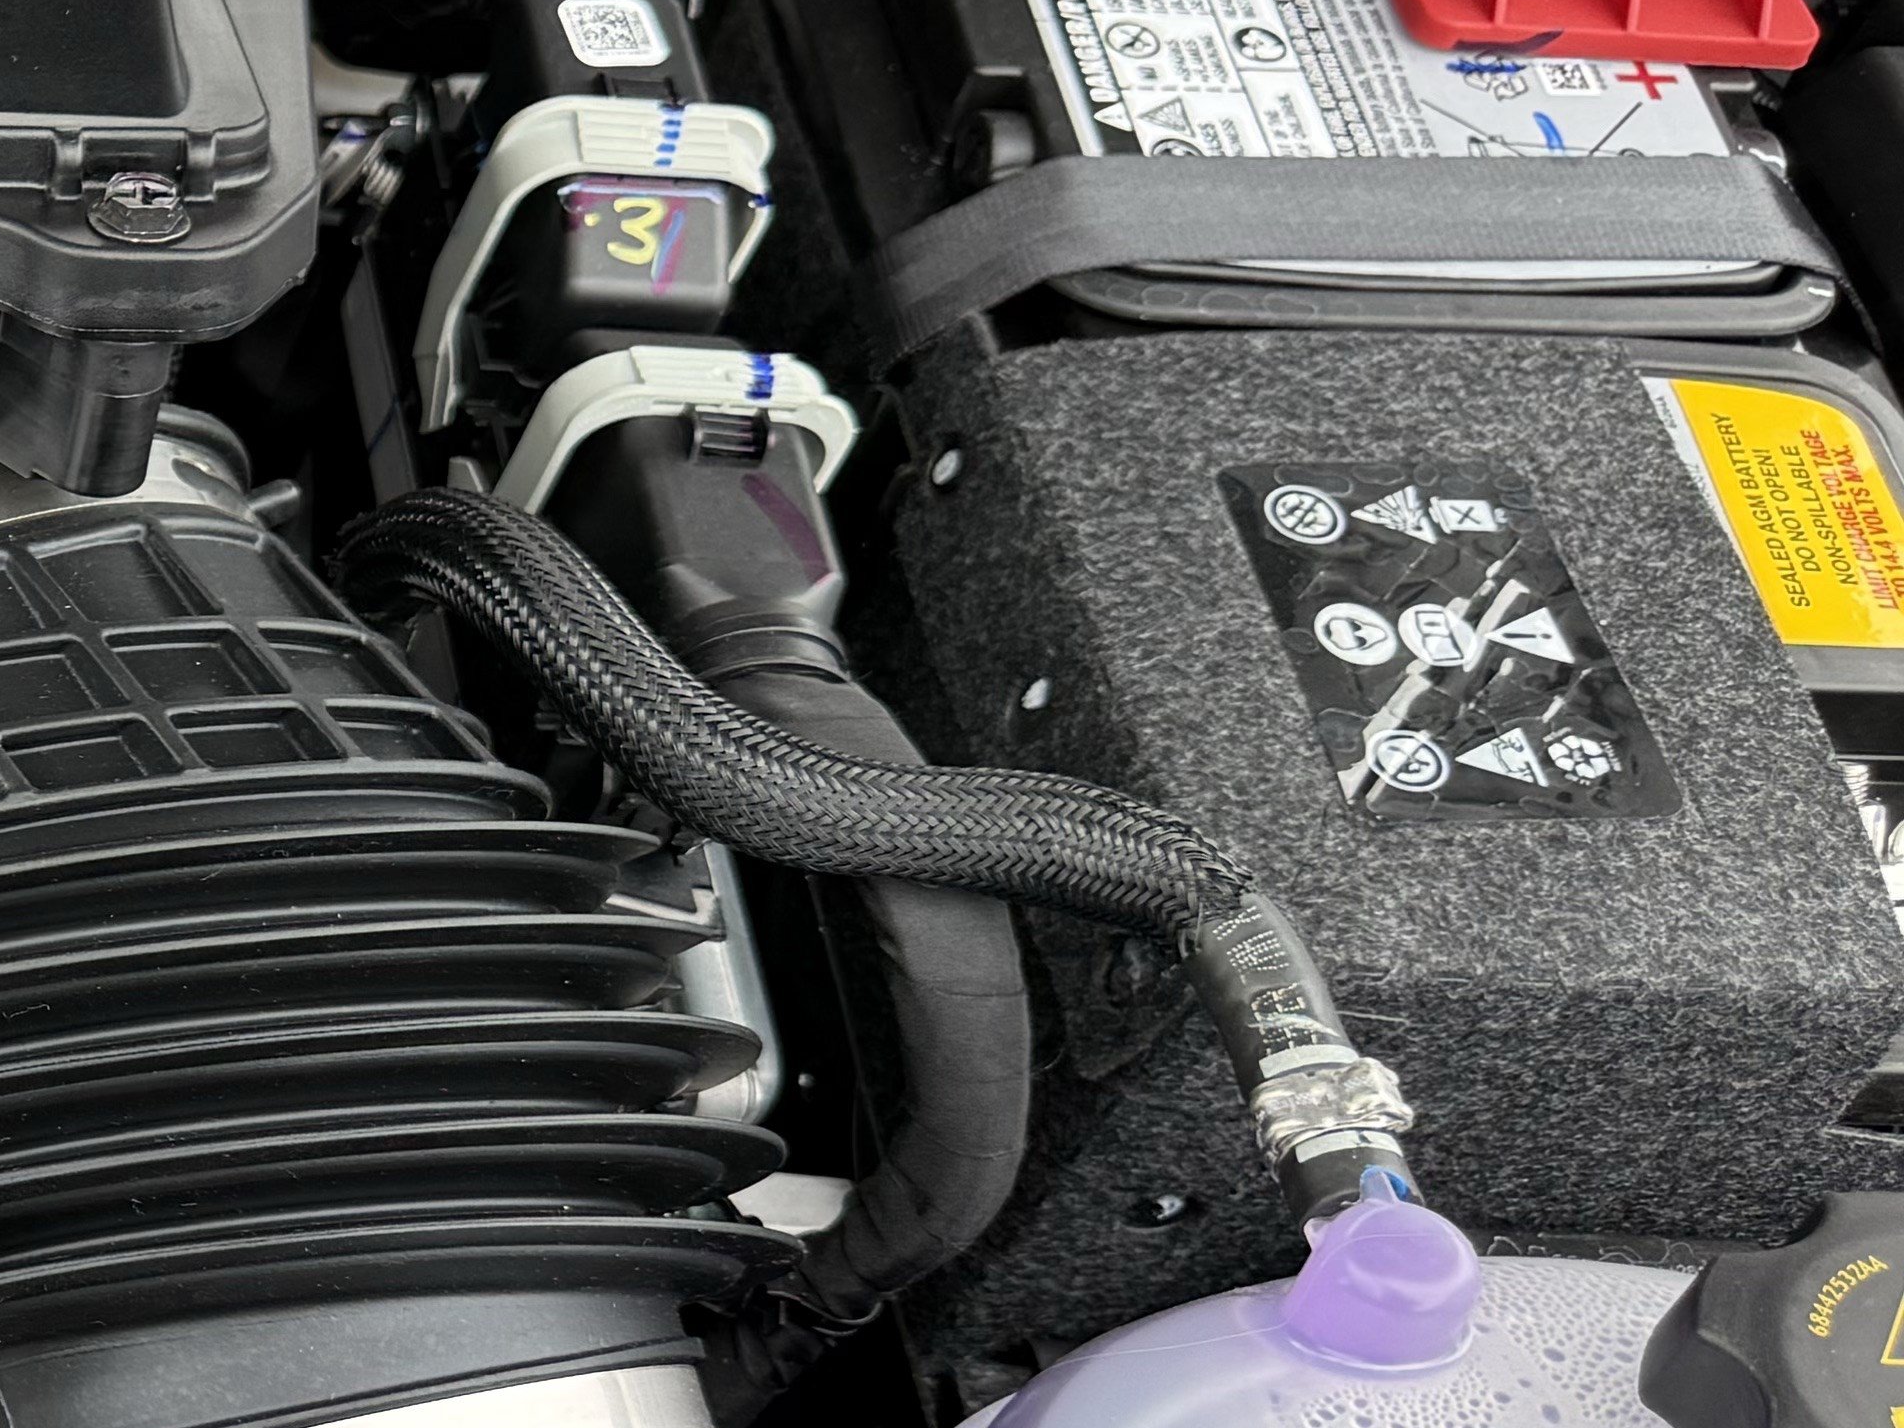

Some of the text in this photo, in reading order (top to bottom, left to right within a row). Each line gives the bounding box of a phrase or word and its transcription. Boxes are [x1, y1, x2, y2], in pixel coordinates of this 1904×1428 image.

[1710, 412, 1811, 607] SEALED AGM BATTERY
[1752, 448, 1822, 572] DO NOT OPEN!
[1781, 444, 1858, 585] NON-SPILLABLE
[1800, 429, 1899, 610] LIMIT CHARGE VOLTAGE
[1849, 486, 1889, 537] VOLTS
[1807, 1254, 1890, 1339] 68442532AA
